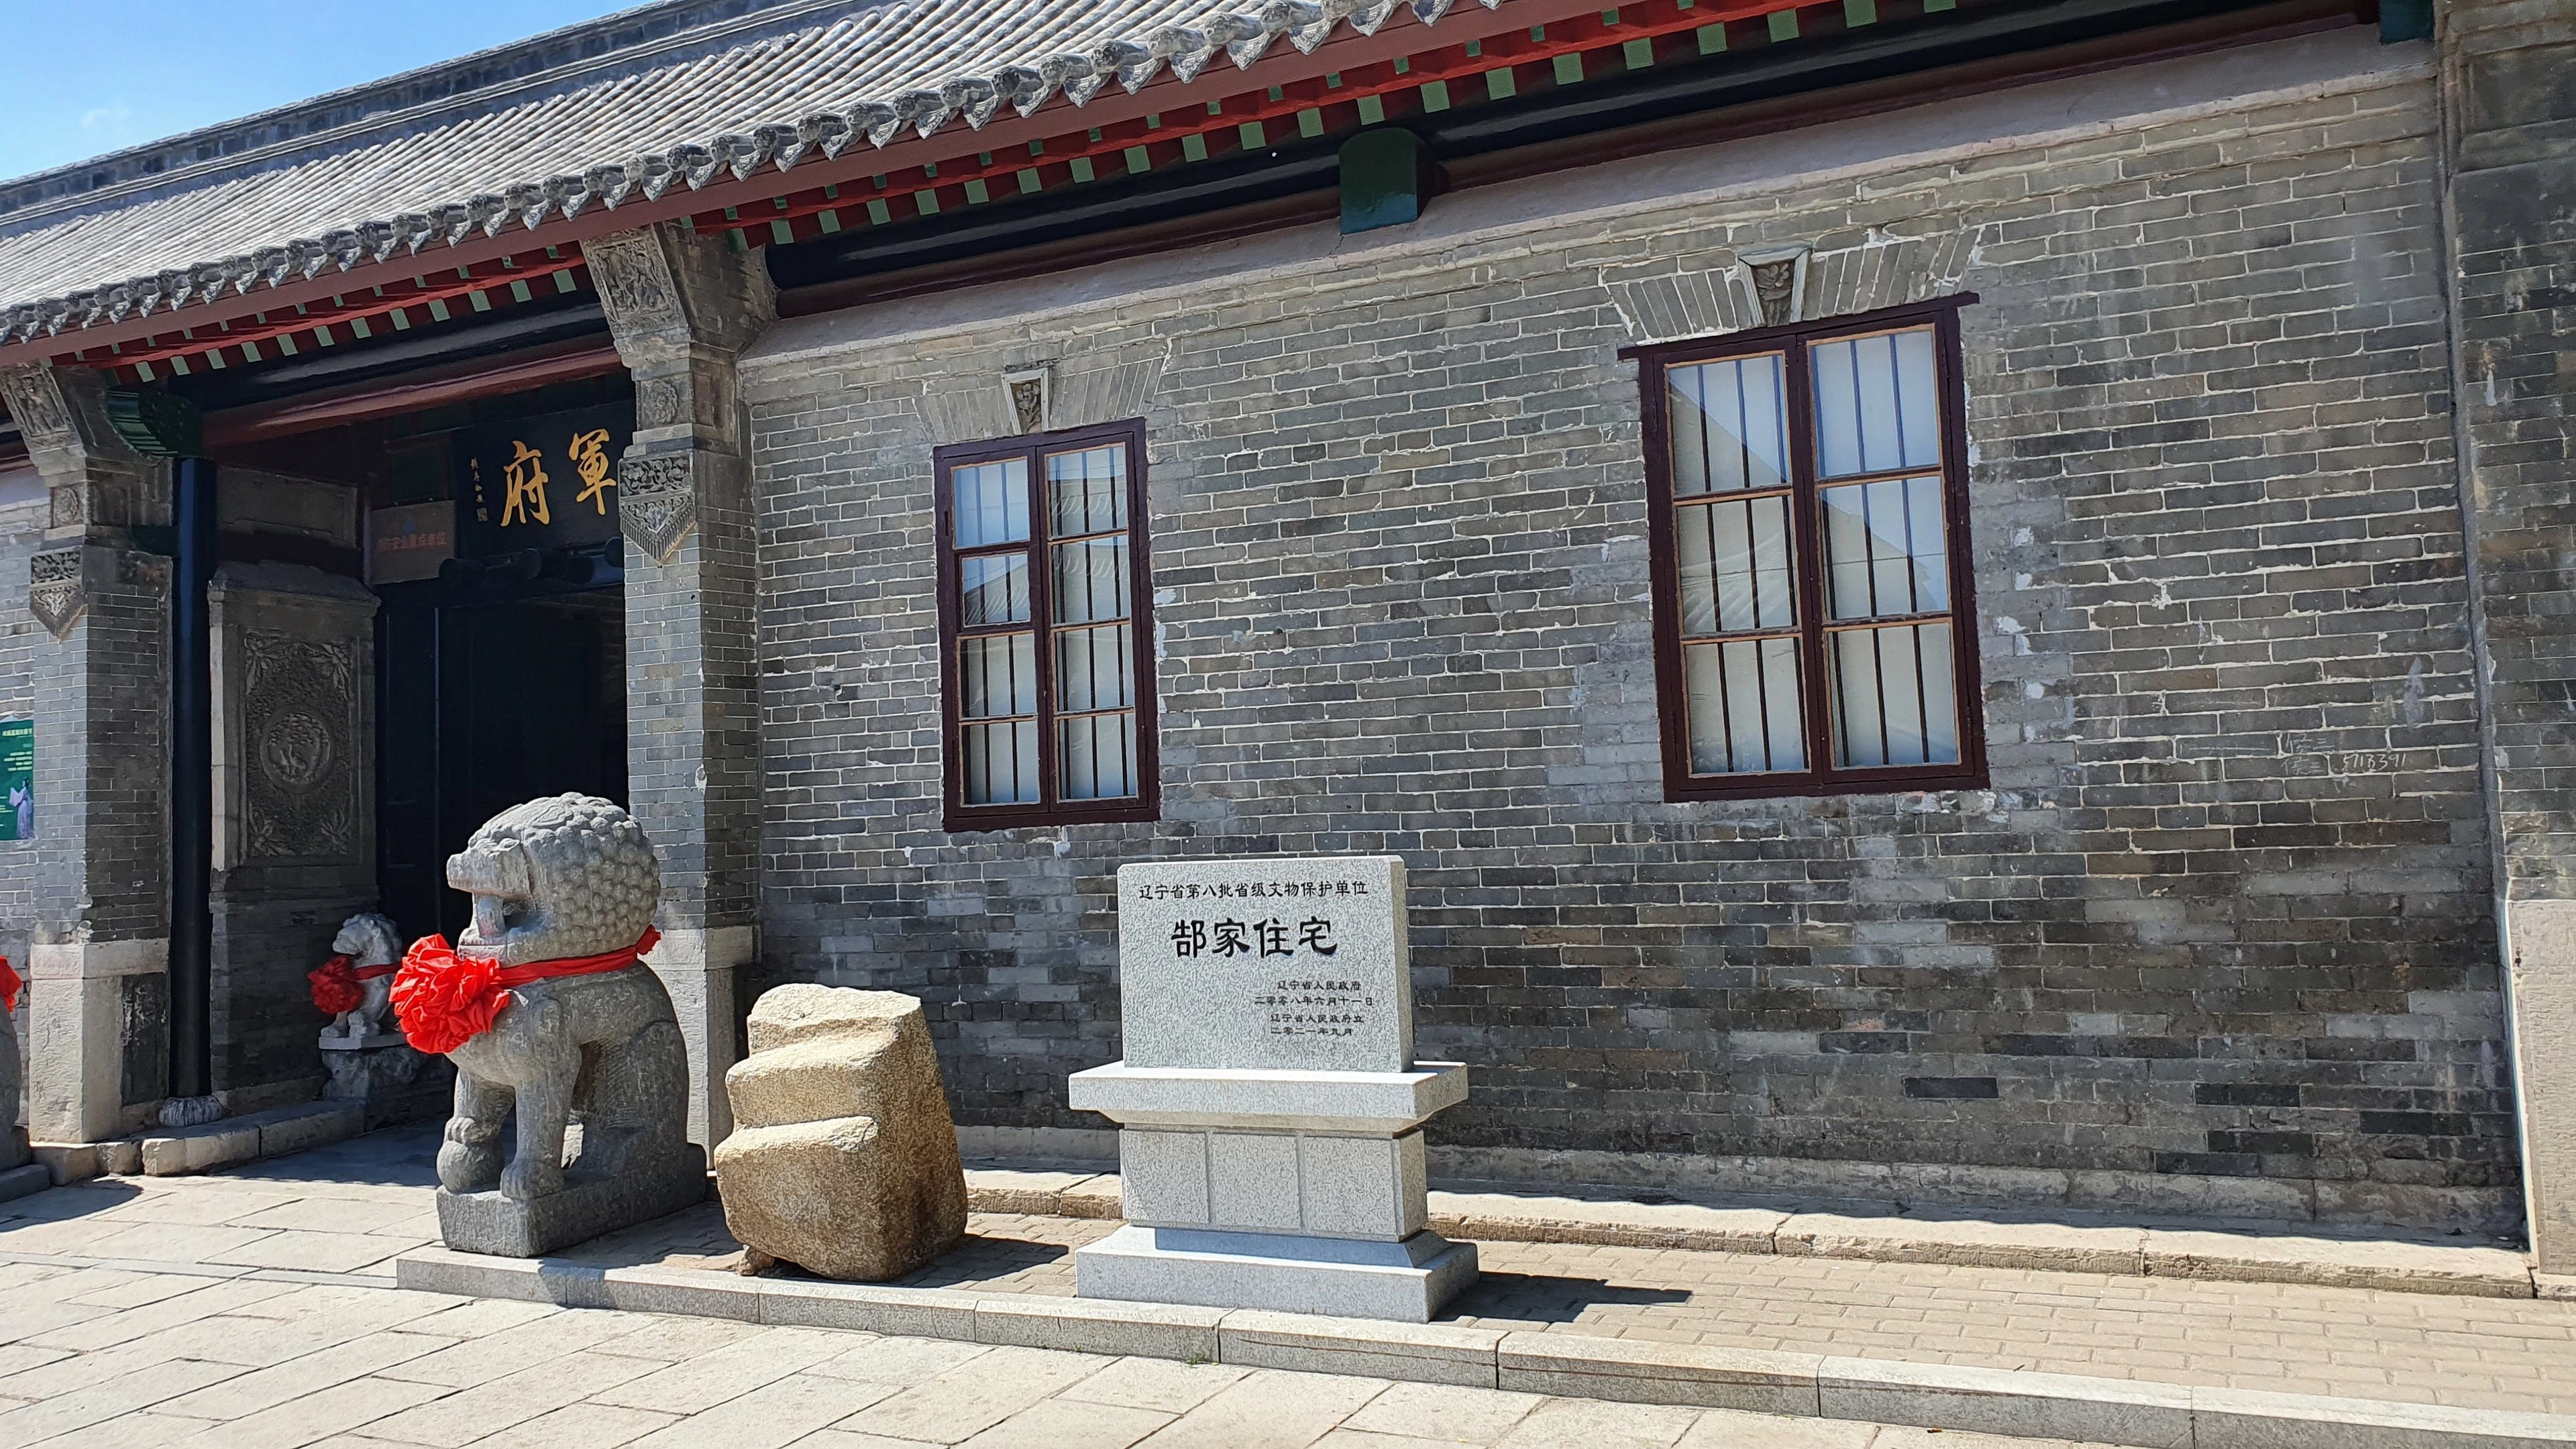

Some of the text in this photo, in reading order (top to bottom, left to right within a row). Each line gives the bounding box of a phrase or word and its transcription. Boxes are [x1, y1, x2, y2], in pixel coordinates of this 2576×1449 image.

[1139, 881, 1368, 900] 辽宁省第八批省级文物保护单位
[1171, 916, 1338, 958] 郜家住宅
[1277, 980, 1362, 991] 辽宁省人民政府
[1254, 997, 1373, 1006] 二零零八年六月十一日
[1271, 1014, 1364, 1024] 辽宁省人民政府立
[1271, 1028, 1353, 1036] 二零二一年九月
